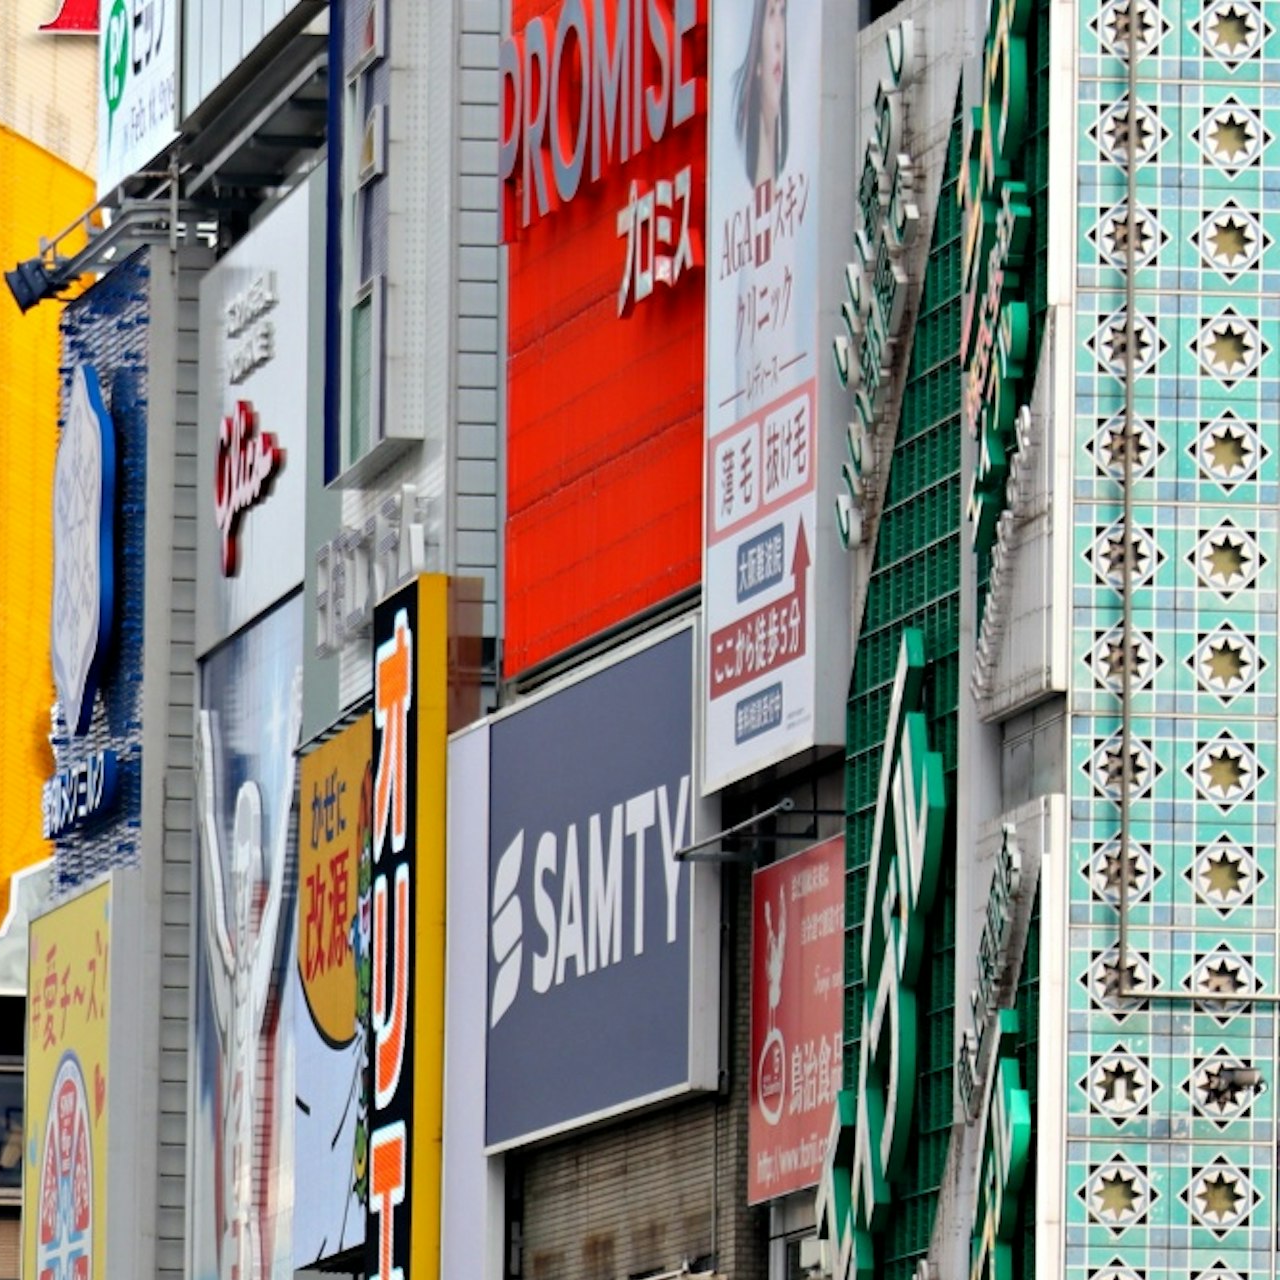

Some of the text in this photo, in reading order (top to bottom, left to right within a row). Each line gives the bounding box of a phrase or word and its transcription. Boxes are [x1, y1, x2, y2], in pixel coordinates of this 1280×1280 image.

[499, 0, 697, 230] PROMISE
[719, 208, 754, 282] AGA
[215, 400, 287, 578] Glico
[715, 597, 801, 684] ここから徒歩5分
[310, 767, 348, 850] かぜに
[305, 850, 350, 982] 改源
[532, 774, 692, 995] SAMTY
